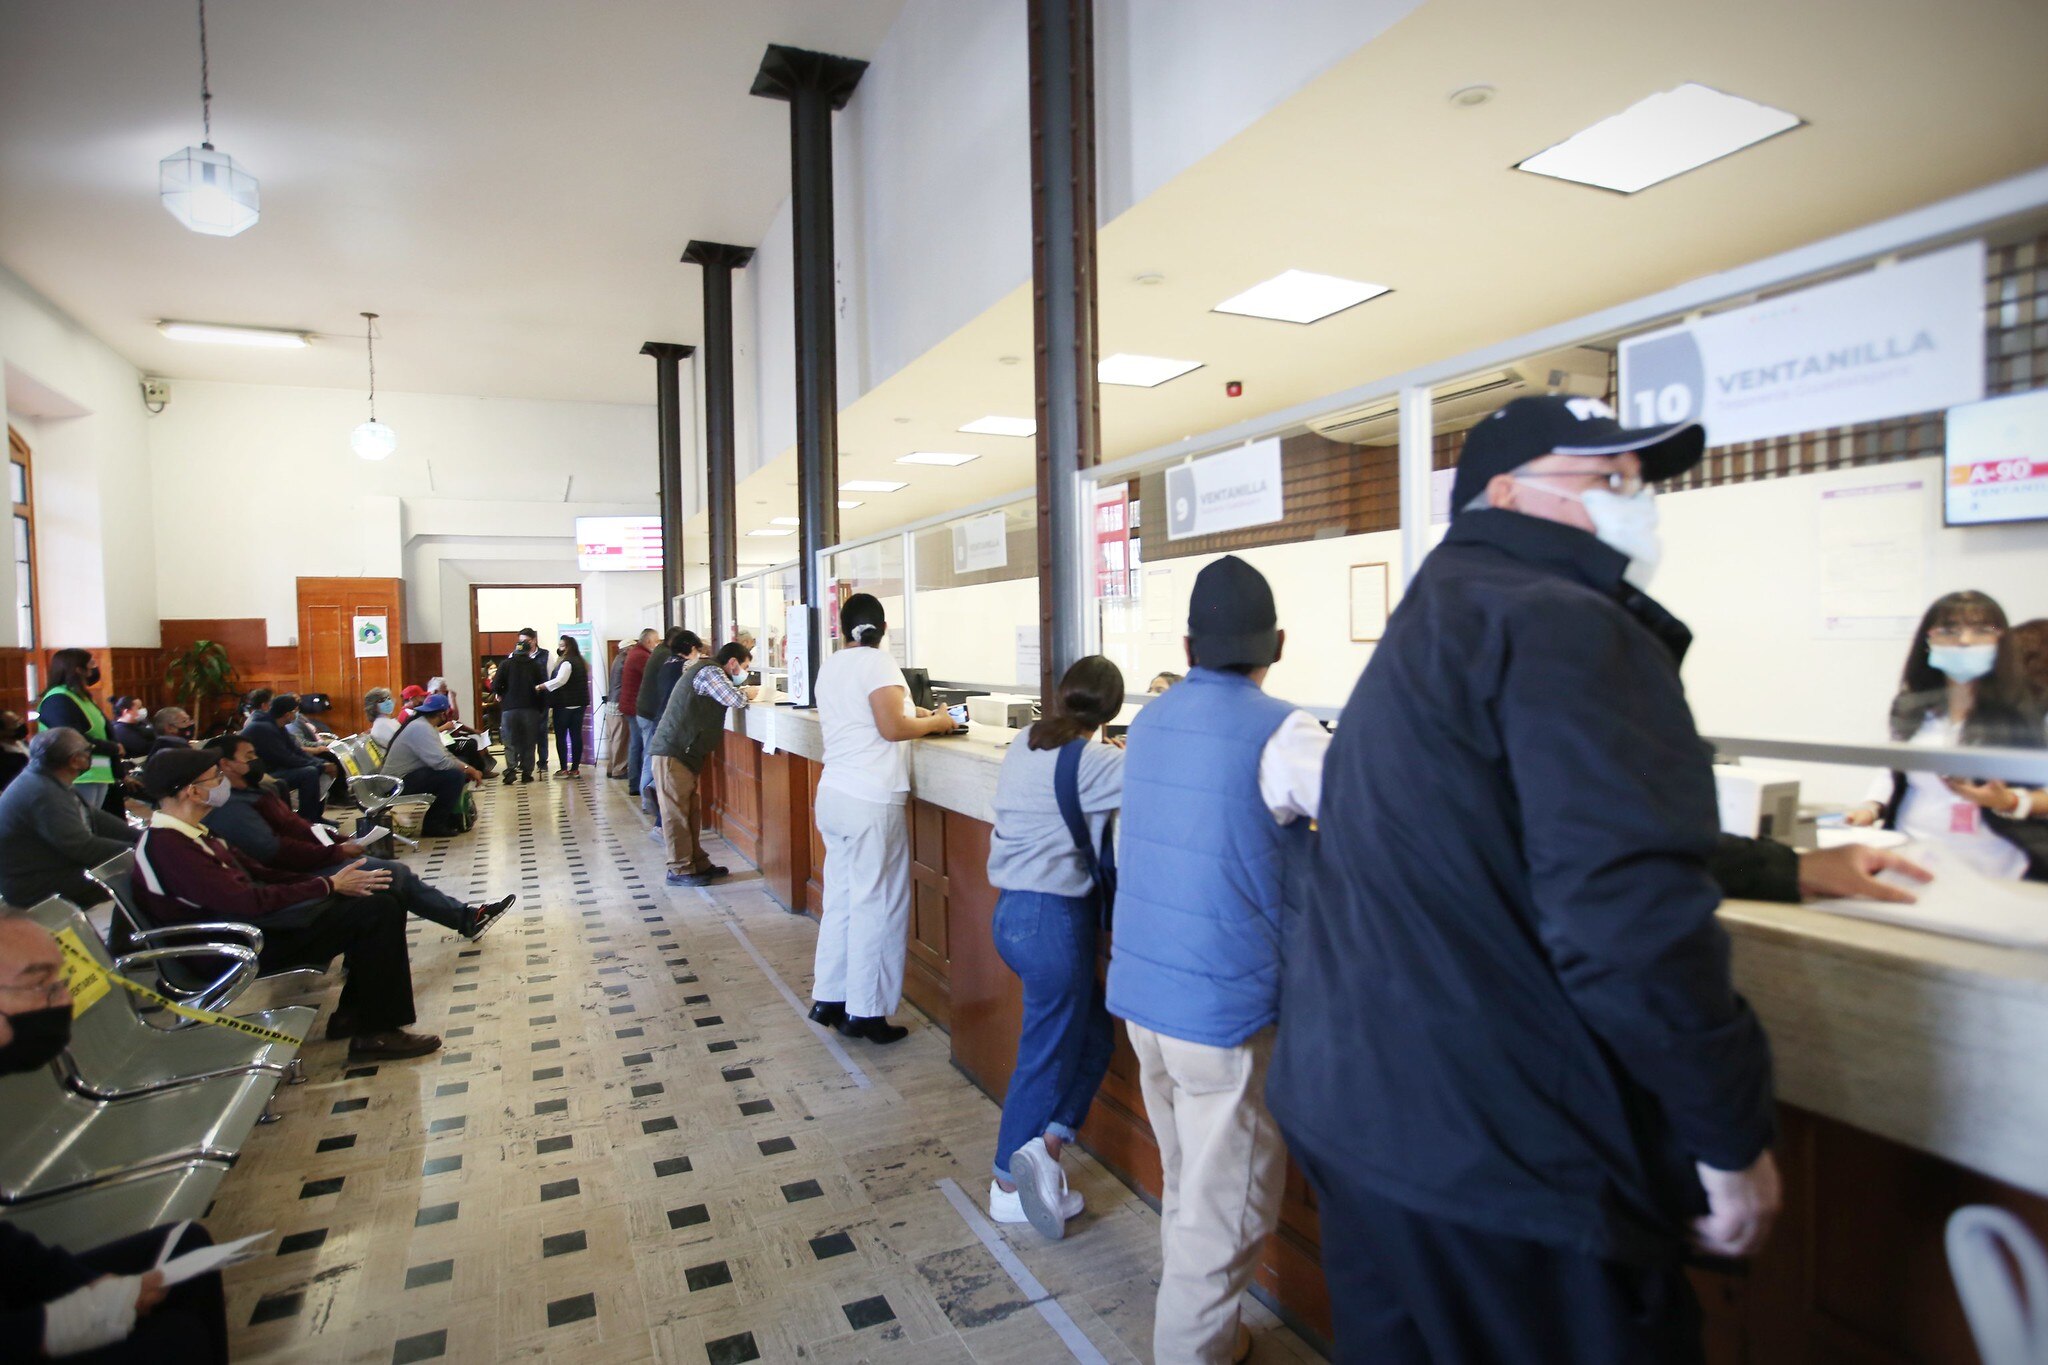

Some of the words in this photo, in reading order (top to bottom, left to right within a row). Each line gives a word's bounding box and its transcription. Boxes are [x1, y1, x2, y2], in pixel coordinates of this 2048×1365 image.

[1634, 382, 1692, 428] 10
[1716, 329, 1936, 394] VENTANILLA
[1970, 458, 2032, 483] A-90
[1176, 497, 1189, 521] 9
[1200, 479, 1267, 504] VENTANILLA
